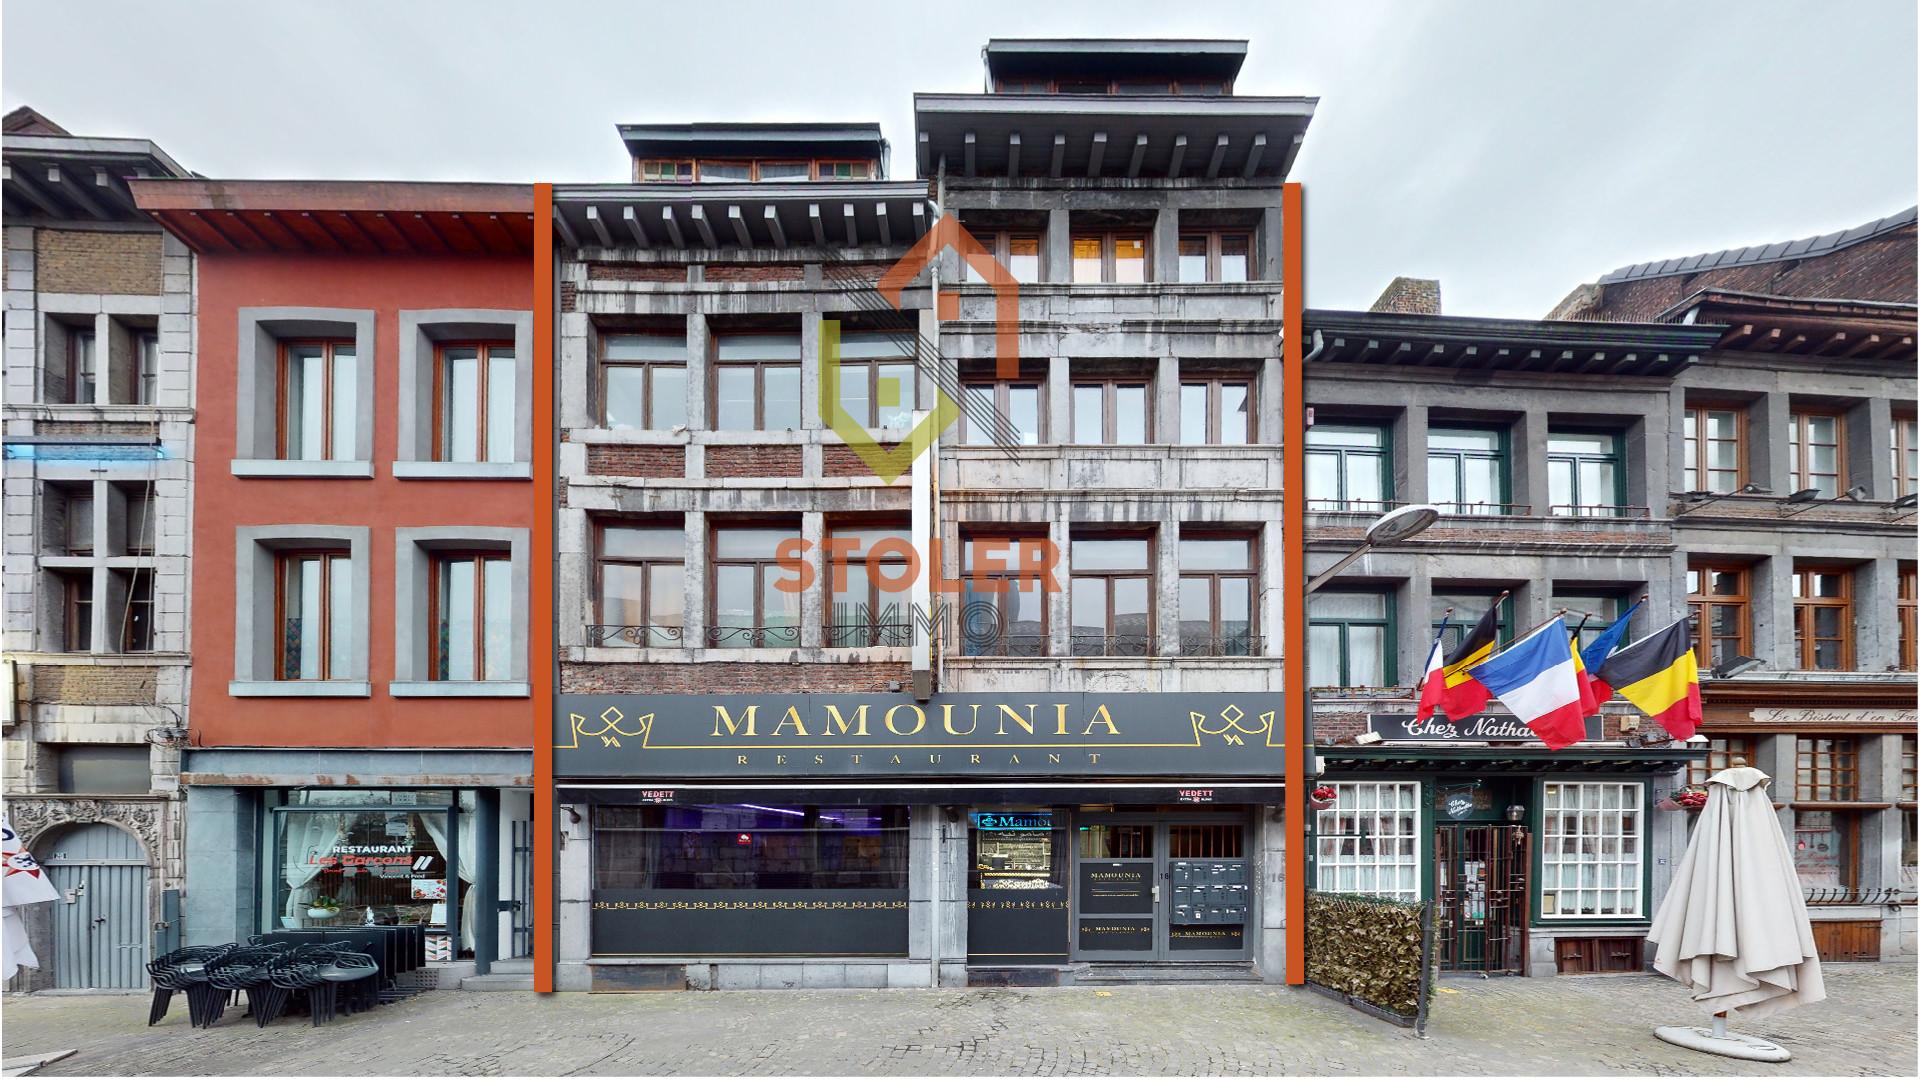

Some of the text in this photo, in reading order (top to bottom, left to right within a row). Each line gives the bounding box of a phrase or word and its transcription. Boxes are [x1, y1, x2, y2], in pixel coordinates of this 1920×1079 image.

[710, 703, 1121, 736] MAMOUNIA
[1401, 717, 1460, 739] Chez
[737, 753, 1101, 765] RESTAURANT
[641, 790, 675, 798] VEDETT
[333, 845, 413, 854] RESTAURANT
